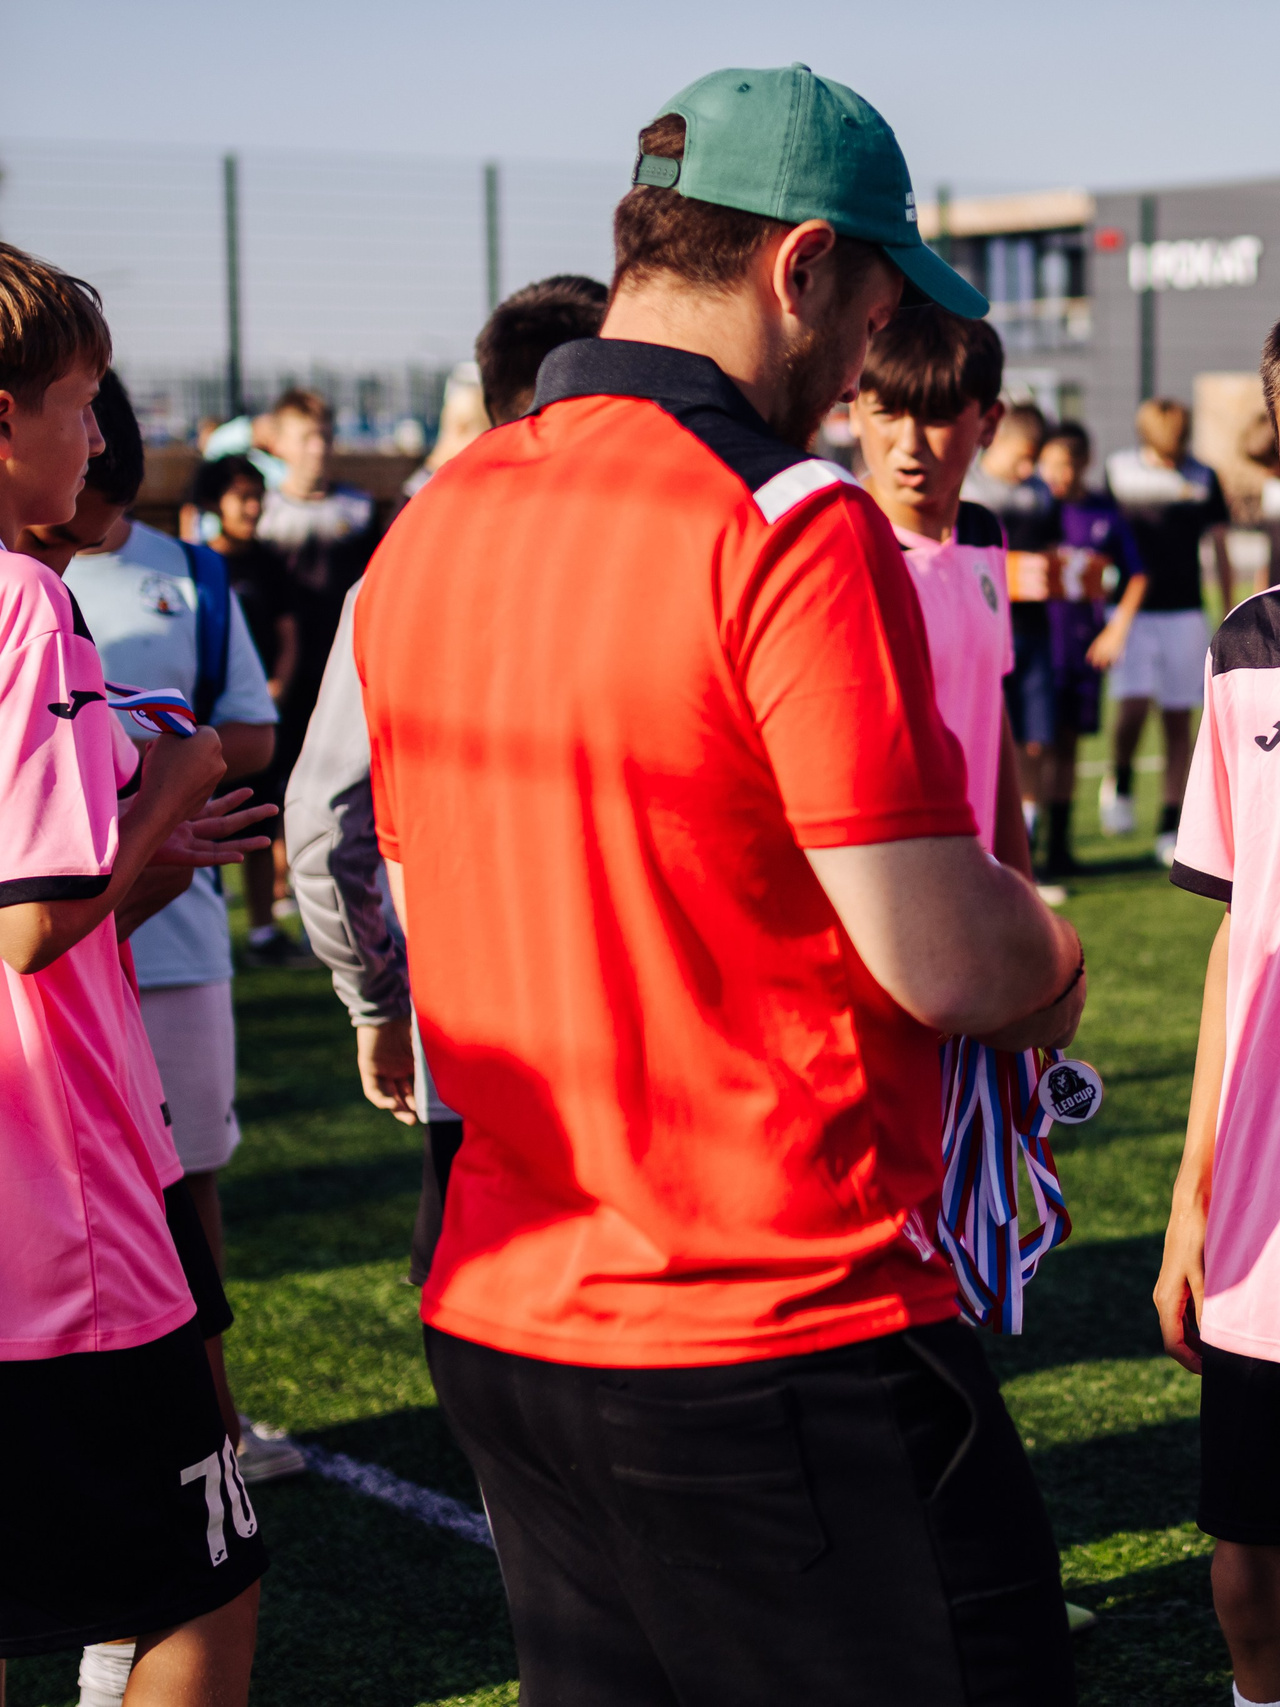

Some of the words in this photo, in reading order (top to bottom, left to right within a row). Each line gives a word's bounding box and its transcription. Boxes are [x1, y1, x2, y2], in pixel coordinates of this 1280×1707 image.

[1055, 1096, 1075, 1114] LEO
[1073, 1086, 1094, 1104] CUP
[180, 1433, 258, 1567] 70
